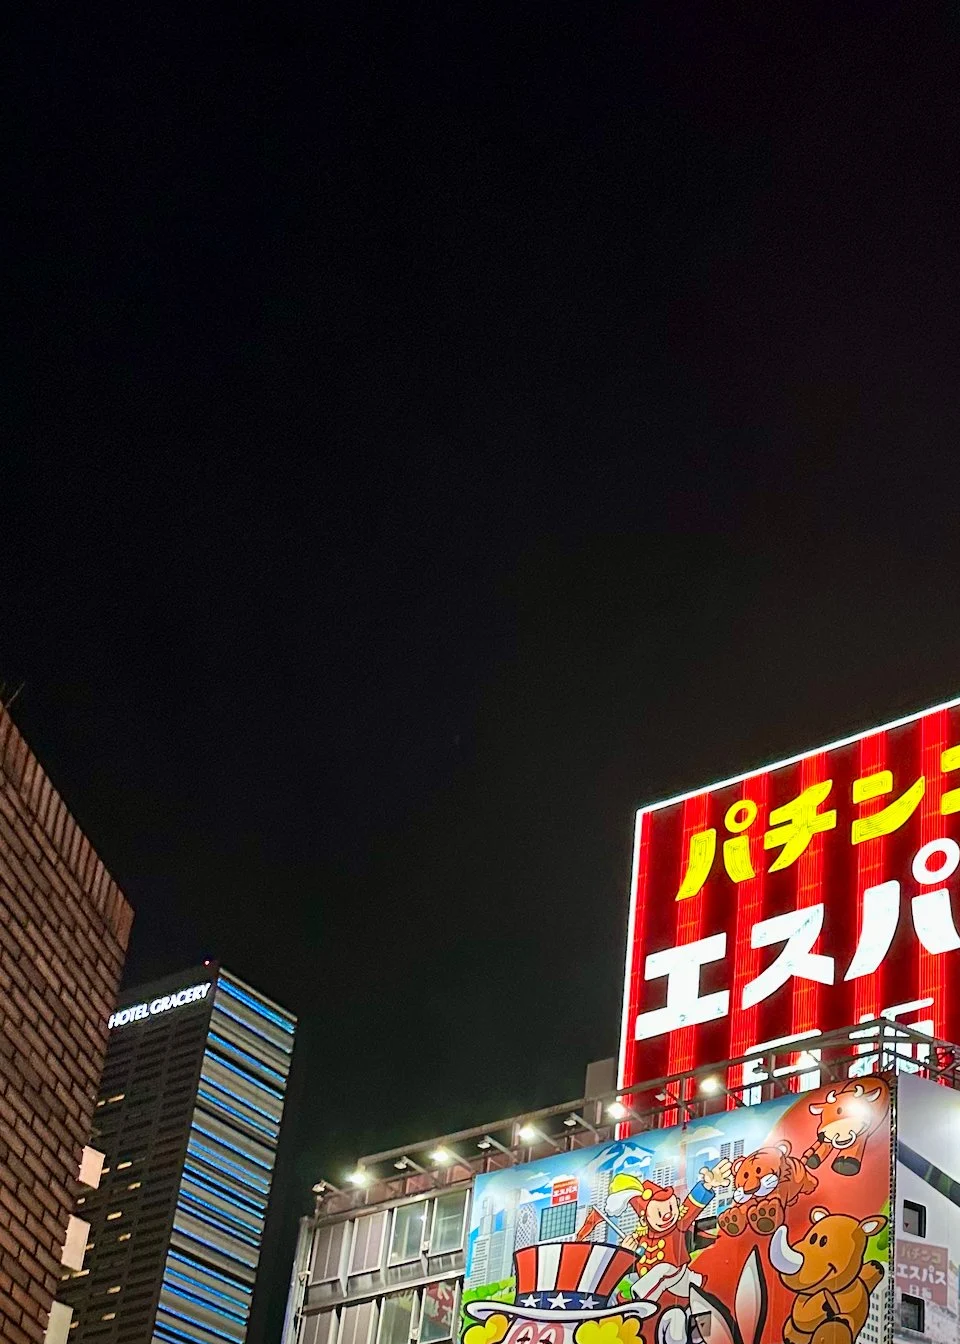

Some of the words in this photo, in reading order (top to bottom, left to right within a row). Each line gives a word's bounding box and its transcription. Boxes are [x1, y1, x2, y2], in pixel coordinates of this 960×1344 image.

[108, 1003, 149, 1029] HOTEL
[150, 982, 211, 1015] GRACERY
[897, 1264, 947, 1286] エスパス
